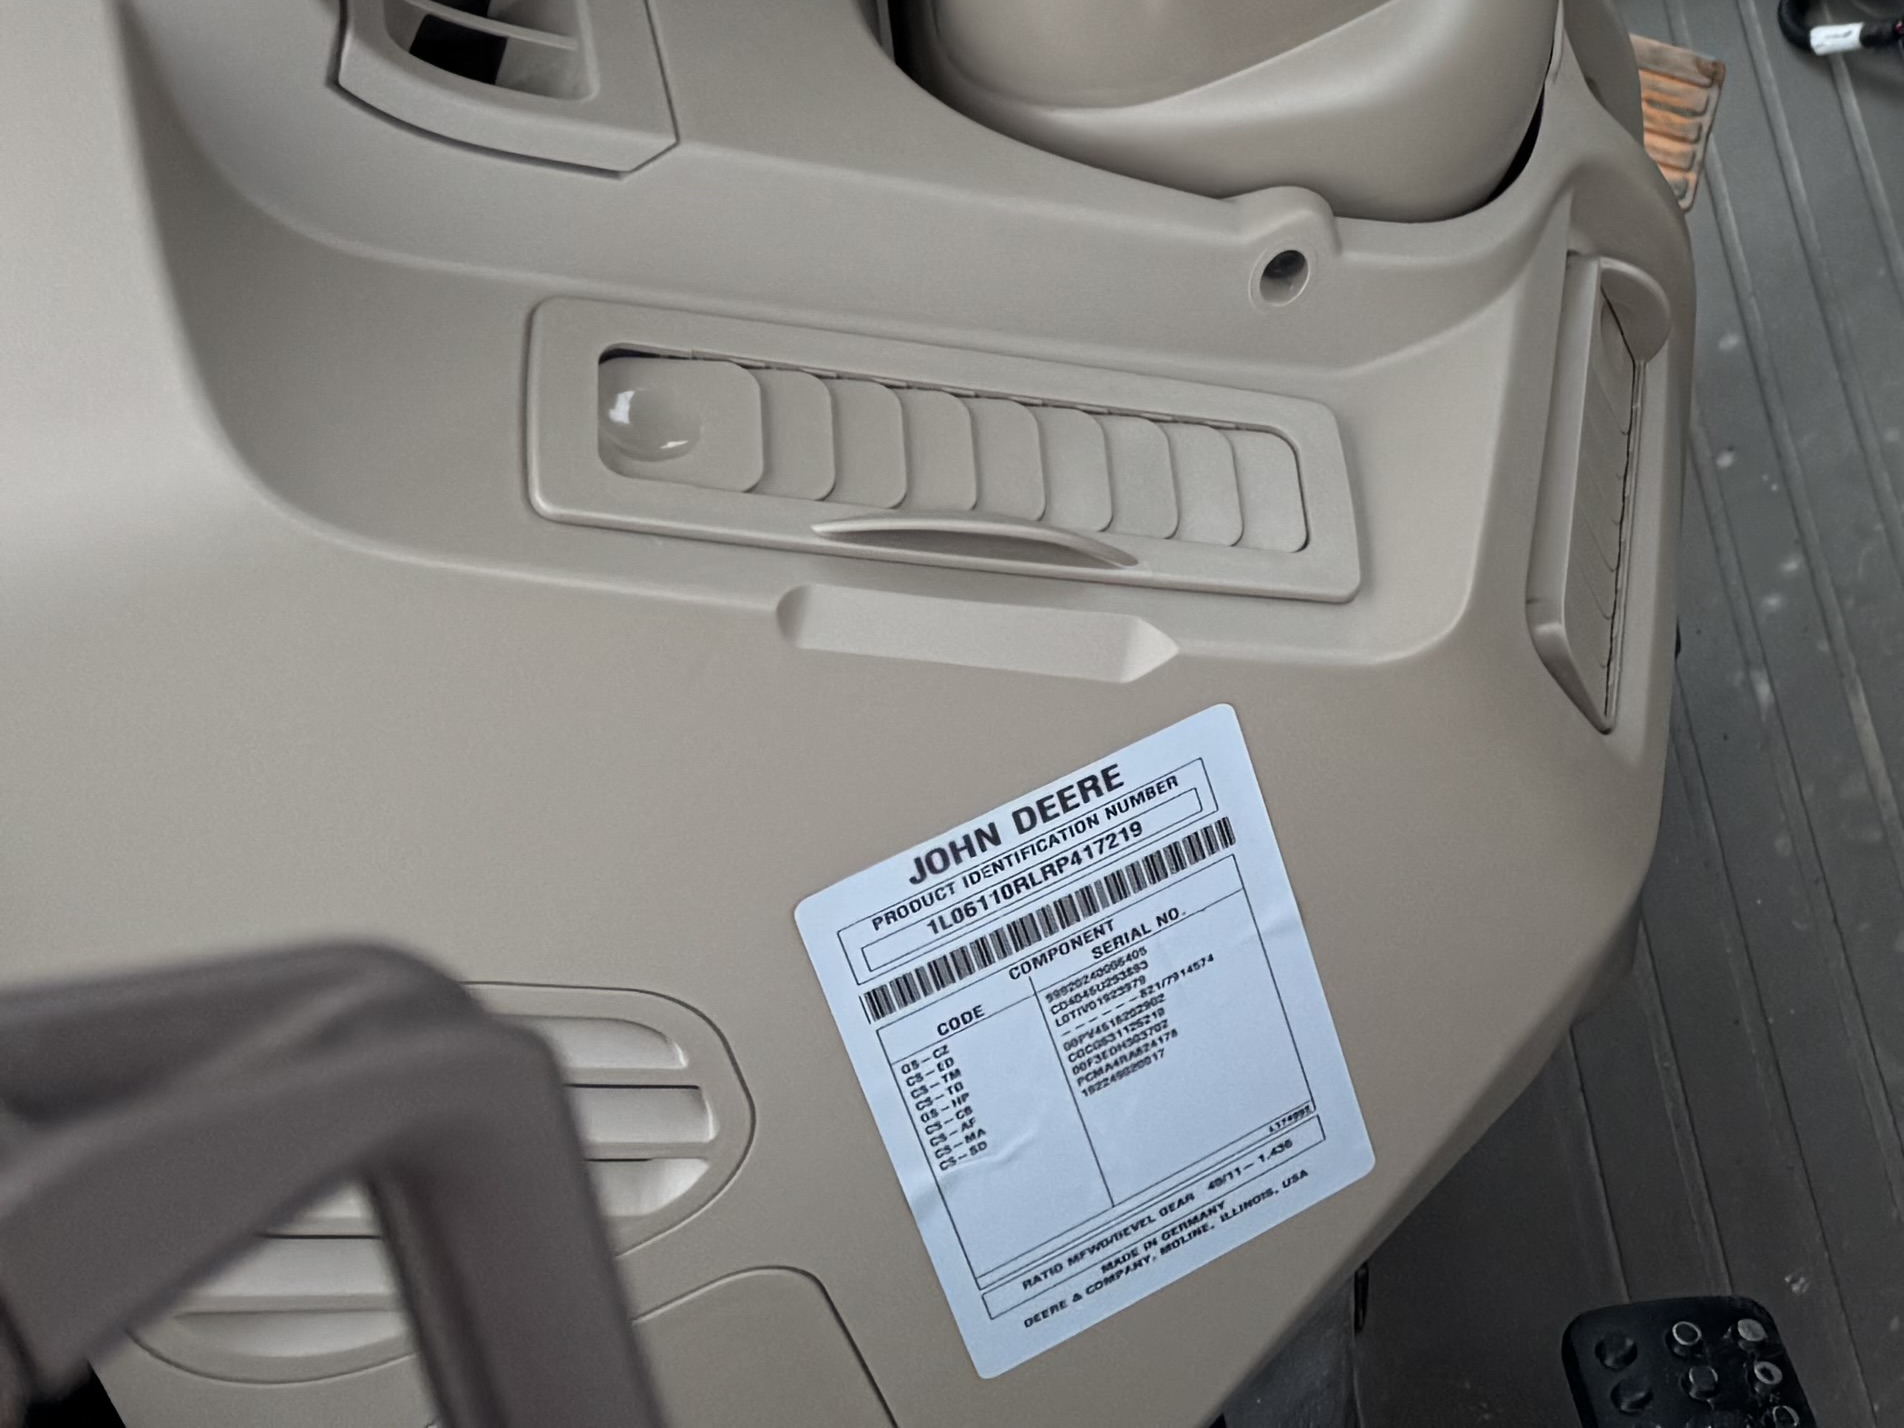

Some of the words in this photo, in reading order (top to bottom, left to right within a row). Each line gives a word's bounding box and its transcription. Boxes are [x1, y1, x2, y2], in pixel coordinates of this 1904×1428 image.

[871, 881, 955, 931] PRODUCT
[961, 812, 1100, 889] IDENTIFICATION
[1104, 775, 1179, 821] NUMBER
[908, 821, 1002, 885] JOHN
[1011, 763, 1125, 835] DEERE
[927, 820, 1143, 935] 1L06110RLRP417219
[1008, 918, 1114, 980] COMPONENT
[1091, 923, 1152, 960] SERIAL
[1155, 907, 1186, 928] NO.
[936, 1004, 985, 1036] CODE
[1023, 1299, 1068, 1328] DEERE
[1072, 1292, 1083, 1303] &
[1281, 1169, 1309, 1189] USA
[1100, 1247, 1140, 1274] MADE
[1143, 1237, 1158, 1252] IN
[1160, 1200, 1225, 1242] GERMANY
[1021, 1262, 1064, 1290] RATIO
